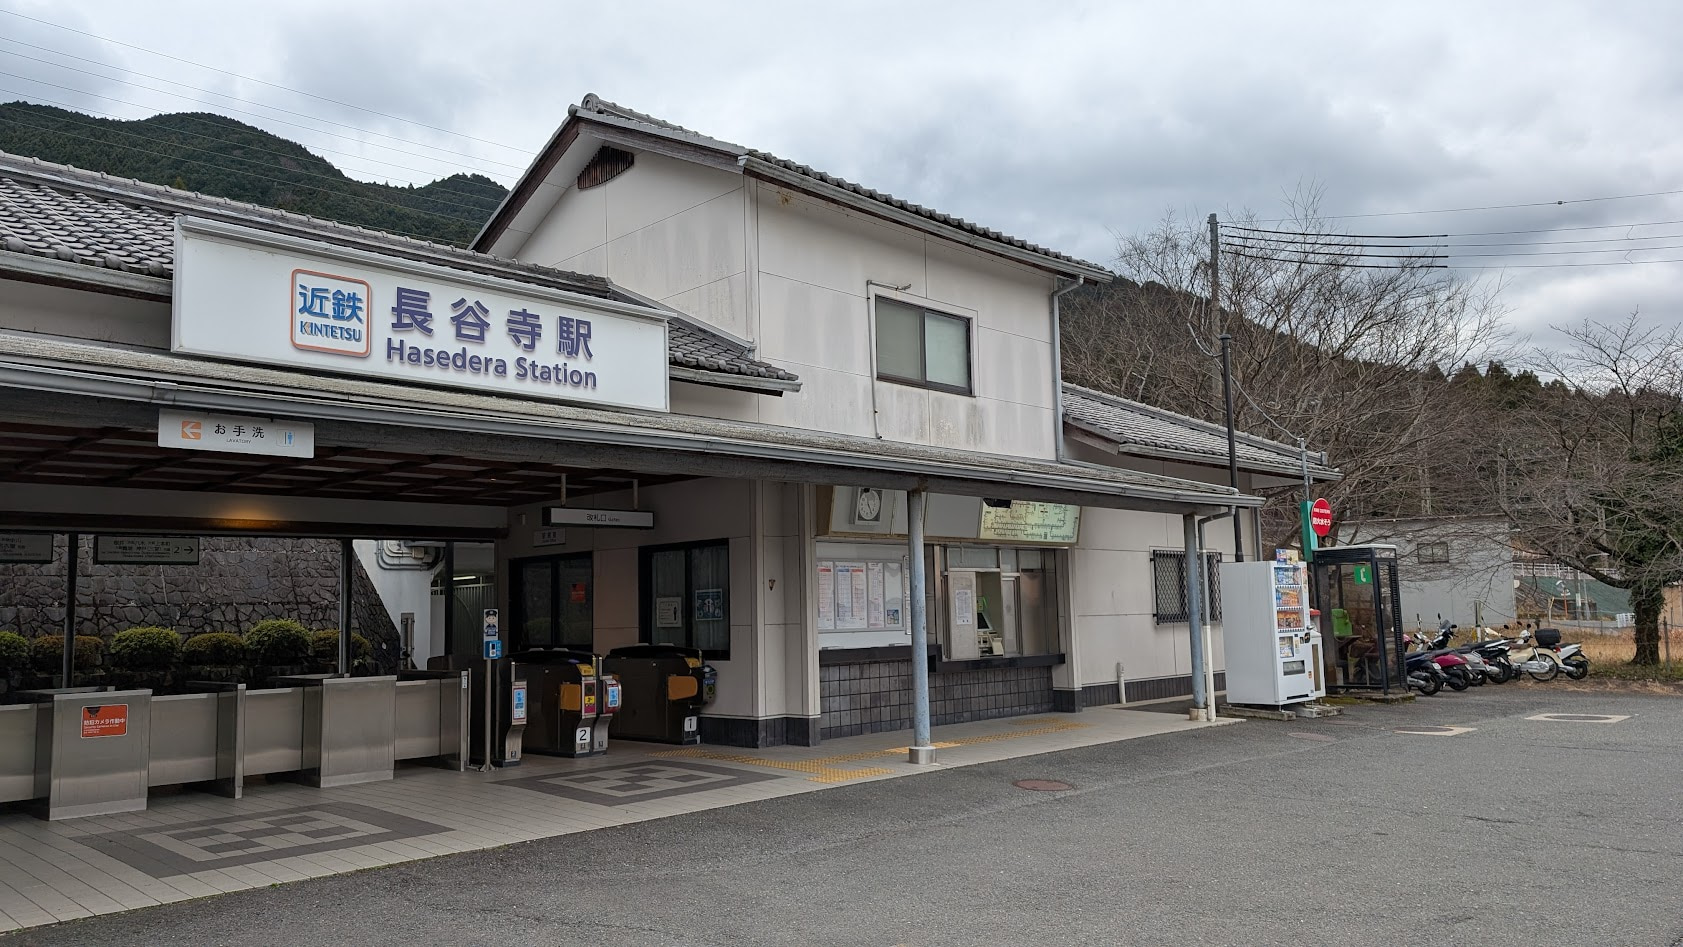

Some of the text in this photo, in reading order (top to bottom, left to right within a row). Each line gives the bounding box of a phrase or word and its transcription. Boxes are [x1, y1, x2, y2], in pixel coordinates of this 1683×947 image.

[298, 283, 364, 324] 近鉄
[300, 321, 363, 342] KINTETSU
[391, 287, 594, 361] 長谷寺駅
[386, 337, 597, 388] Hasedera Station
[214, 423, 265, 439] お手洗
[586, 513, 607, 522] 改札口
[173, 546, 180, 554] 2
[687, 718, 694, 730] 1
[579, 729, 587, 741] 2
